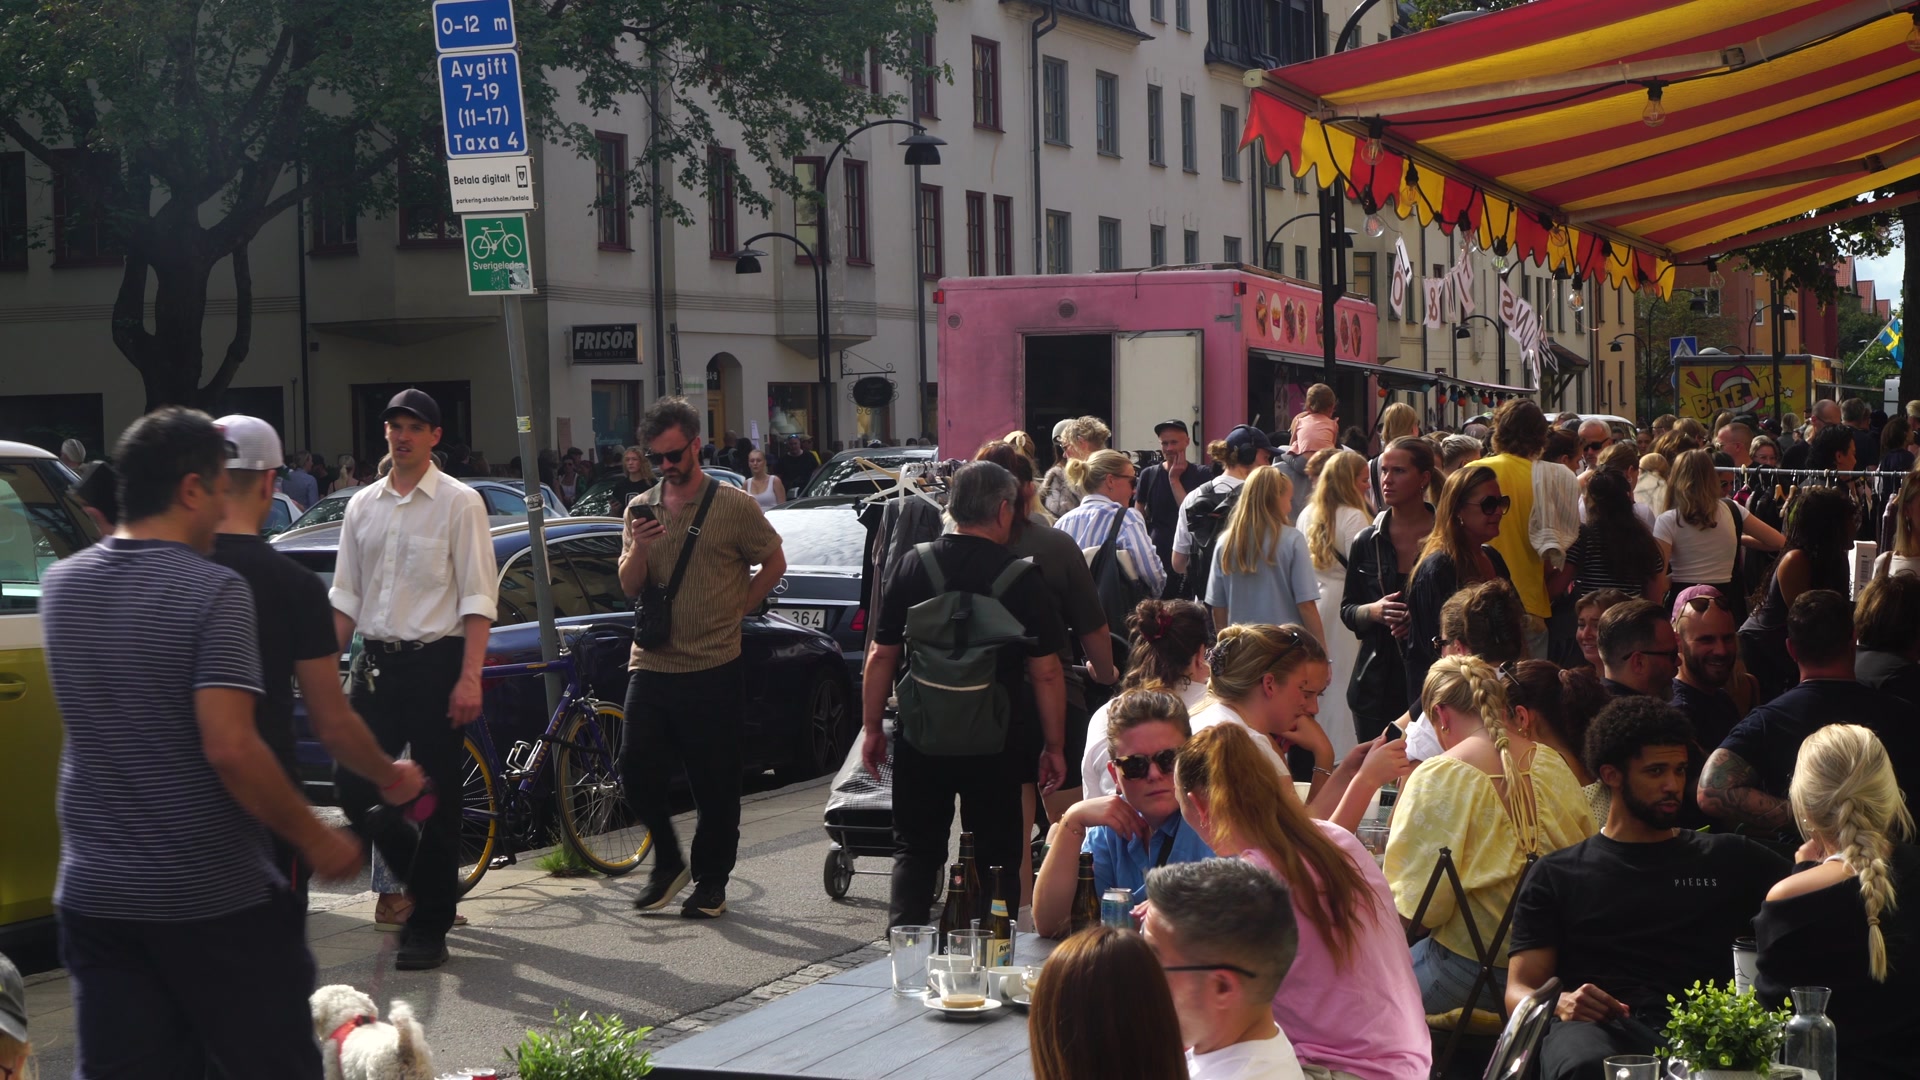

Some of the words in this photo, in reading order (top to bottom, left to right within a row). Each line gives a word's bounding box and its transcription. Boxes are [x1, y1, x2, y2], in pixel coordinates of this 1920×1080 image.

[441, 15, 480, 35] 0-12
[493, 17, 508, 31] m
[451, 57, 508, 81] Avgift
[462, 82, 500, 102] 7-19
[458, 105, 509, 129] (11-17)
[453, 133, 500, 151] Taxa
[507, 131, 519, 149] 4
[453, 176, 480, 185] Betala
[482, 173, 511, 186] digitalt
[574, 326, 635, 350] FRISÖR
[792, 611, 820, 626] 364
[1674, 877, 1717, 887] PIECES
